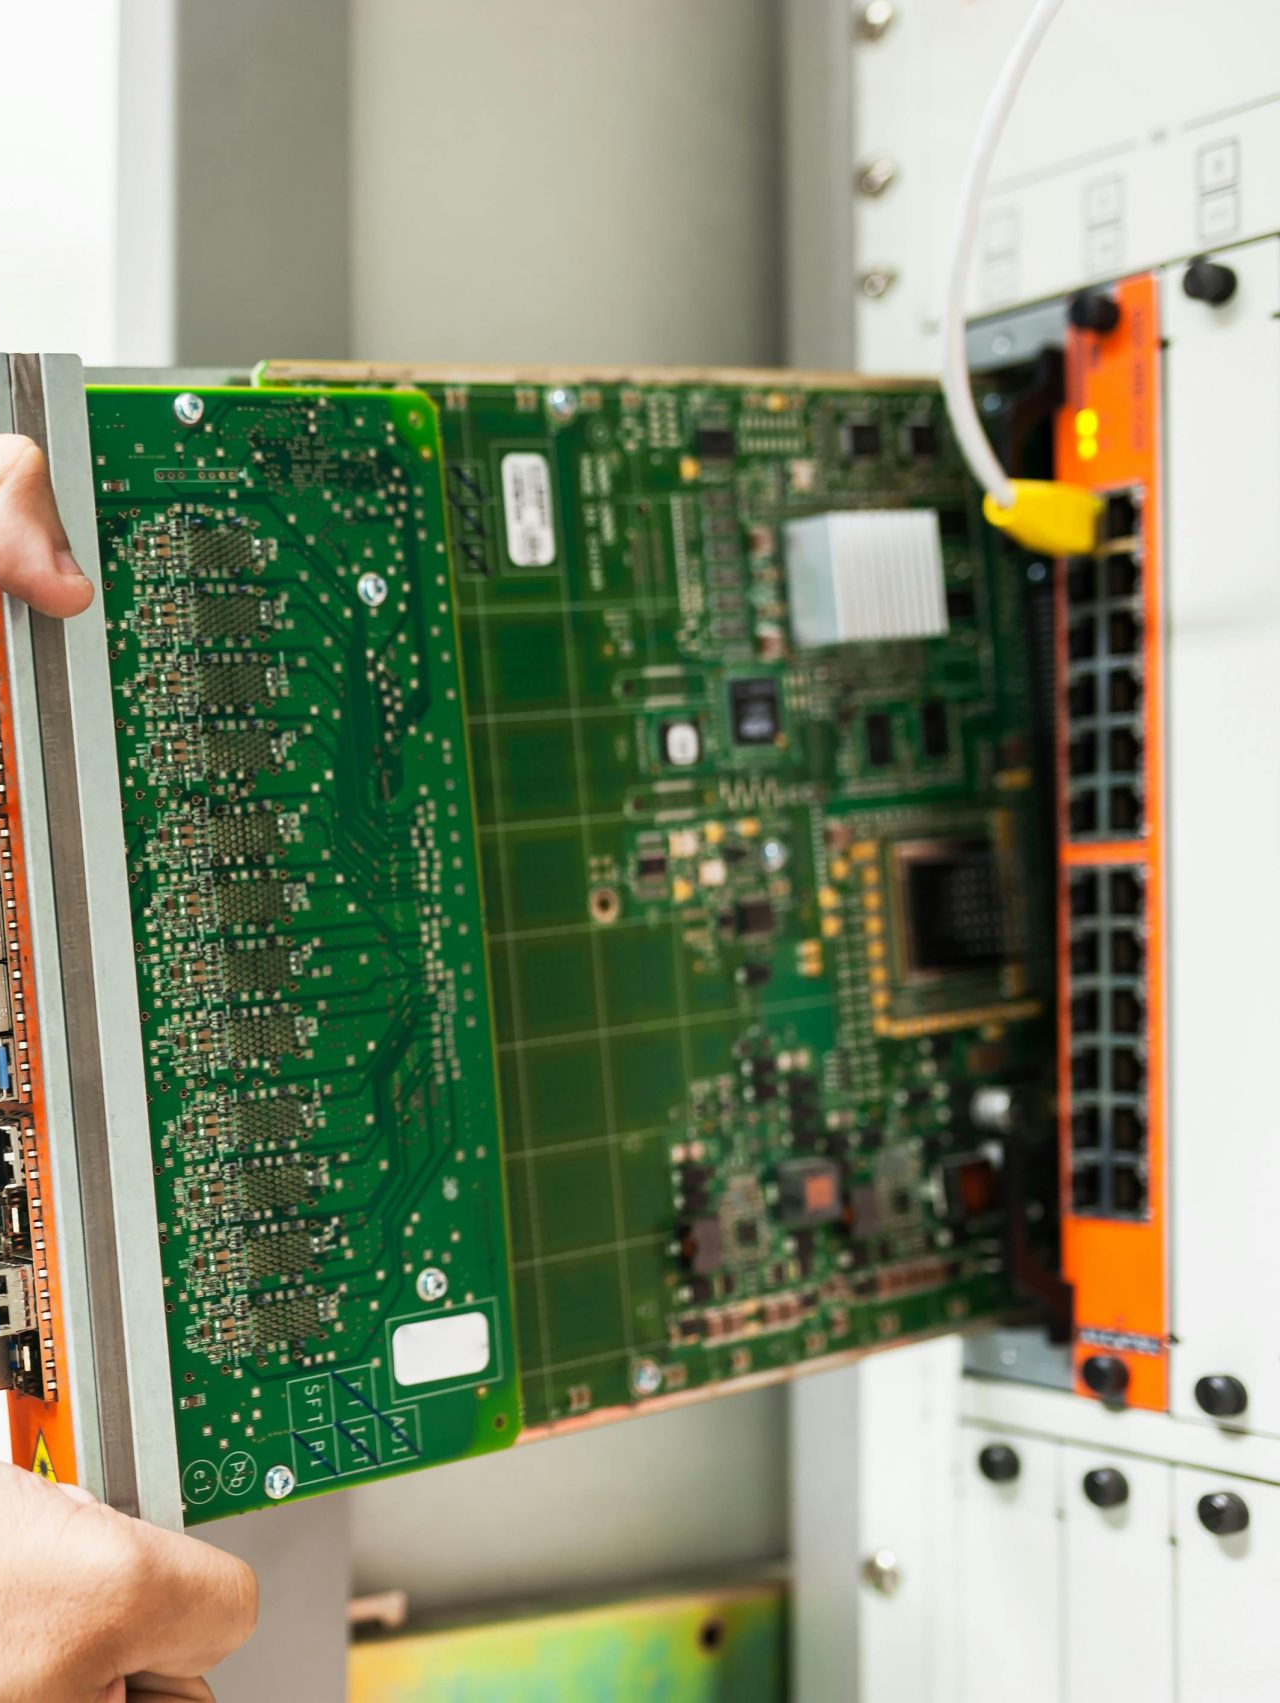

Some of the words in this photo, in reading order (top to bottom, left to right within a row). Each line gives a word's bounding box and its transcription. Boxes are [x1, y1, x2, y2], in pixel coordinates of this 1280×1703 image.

[304, 1384, 324, 1423] SFT
[349, 1426, 369, 1463] ICT
[390, 1416, 409, 1455] AOI
[193, 1470, 211, 1494] e1
[229, 1461, 247, 1488] Pb
